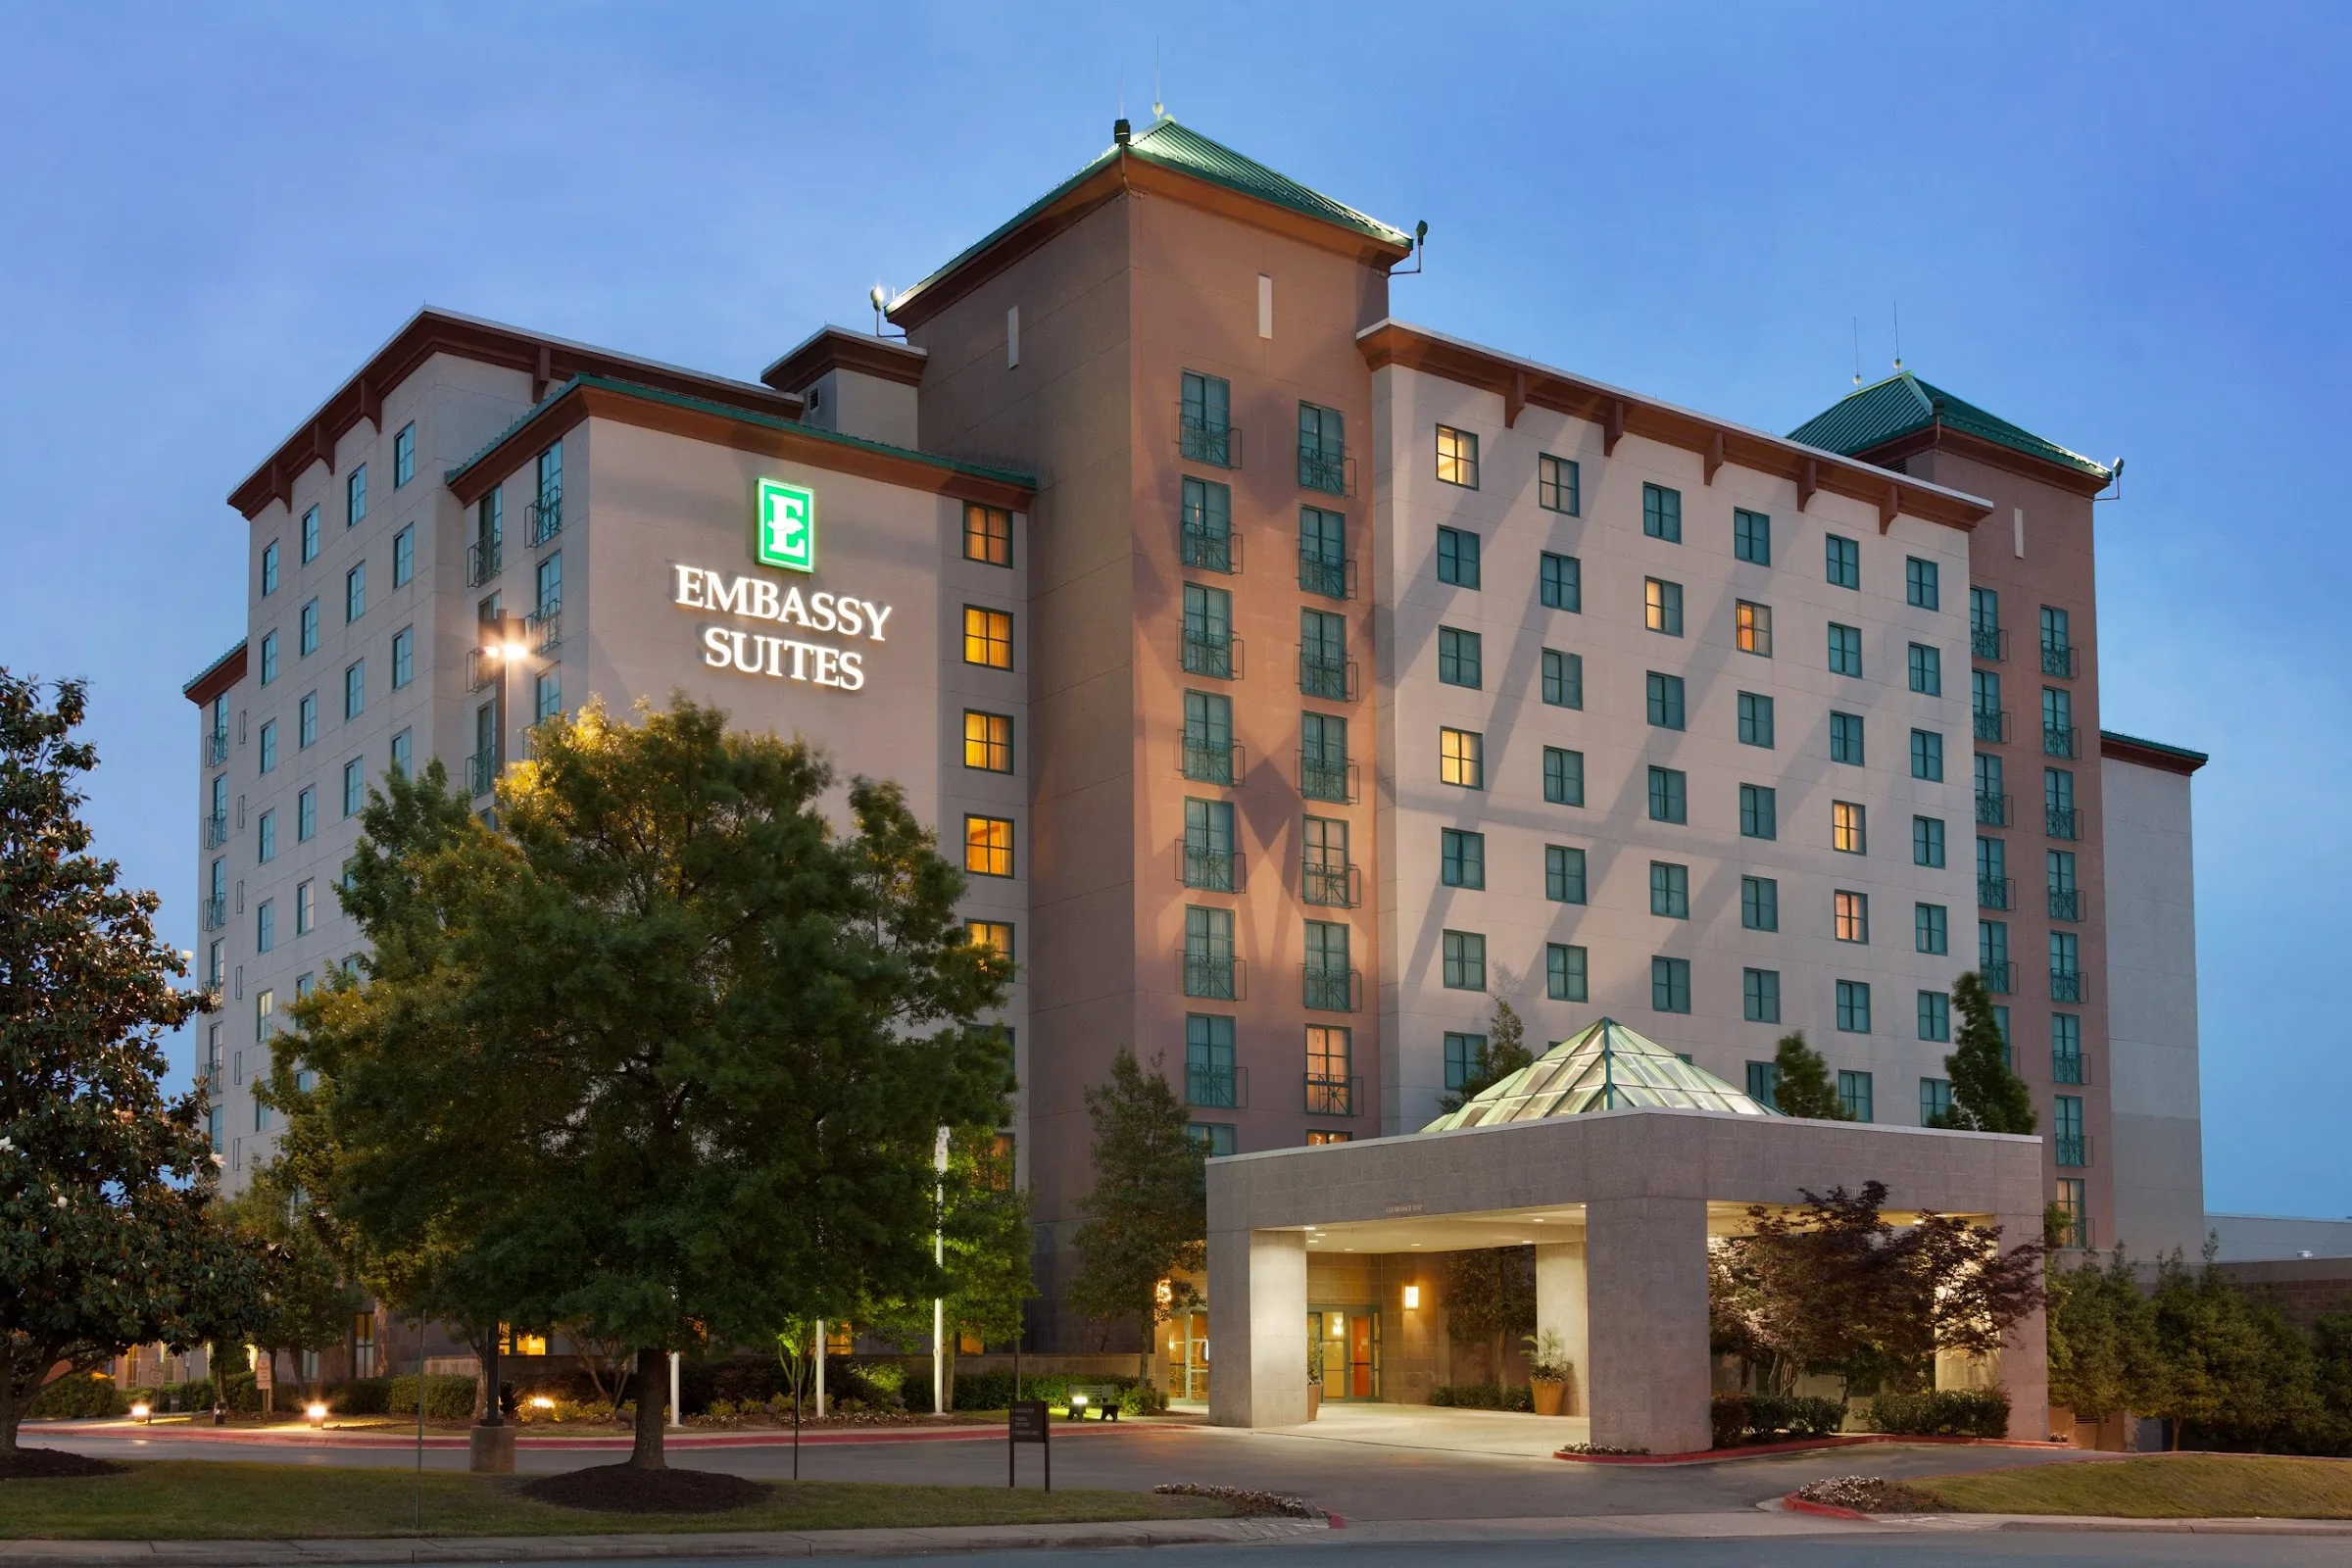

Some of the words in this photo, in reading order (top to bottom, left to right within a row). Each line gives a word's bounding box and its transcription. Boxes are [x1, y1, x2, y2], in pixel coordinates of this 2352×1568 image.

[765, 491, 808, 560] E
[674, 564, 893, 642] EMBASSY
[704, 626, 865, 691] SUITES
